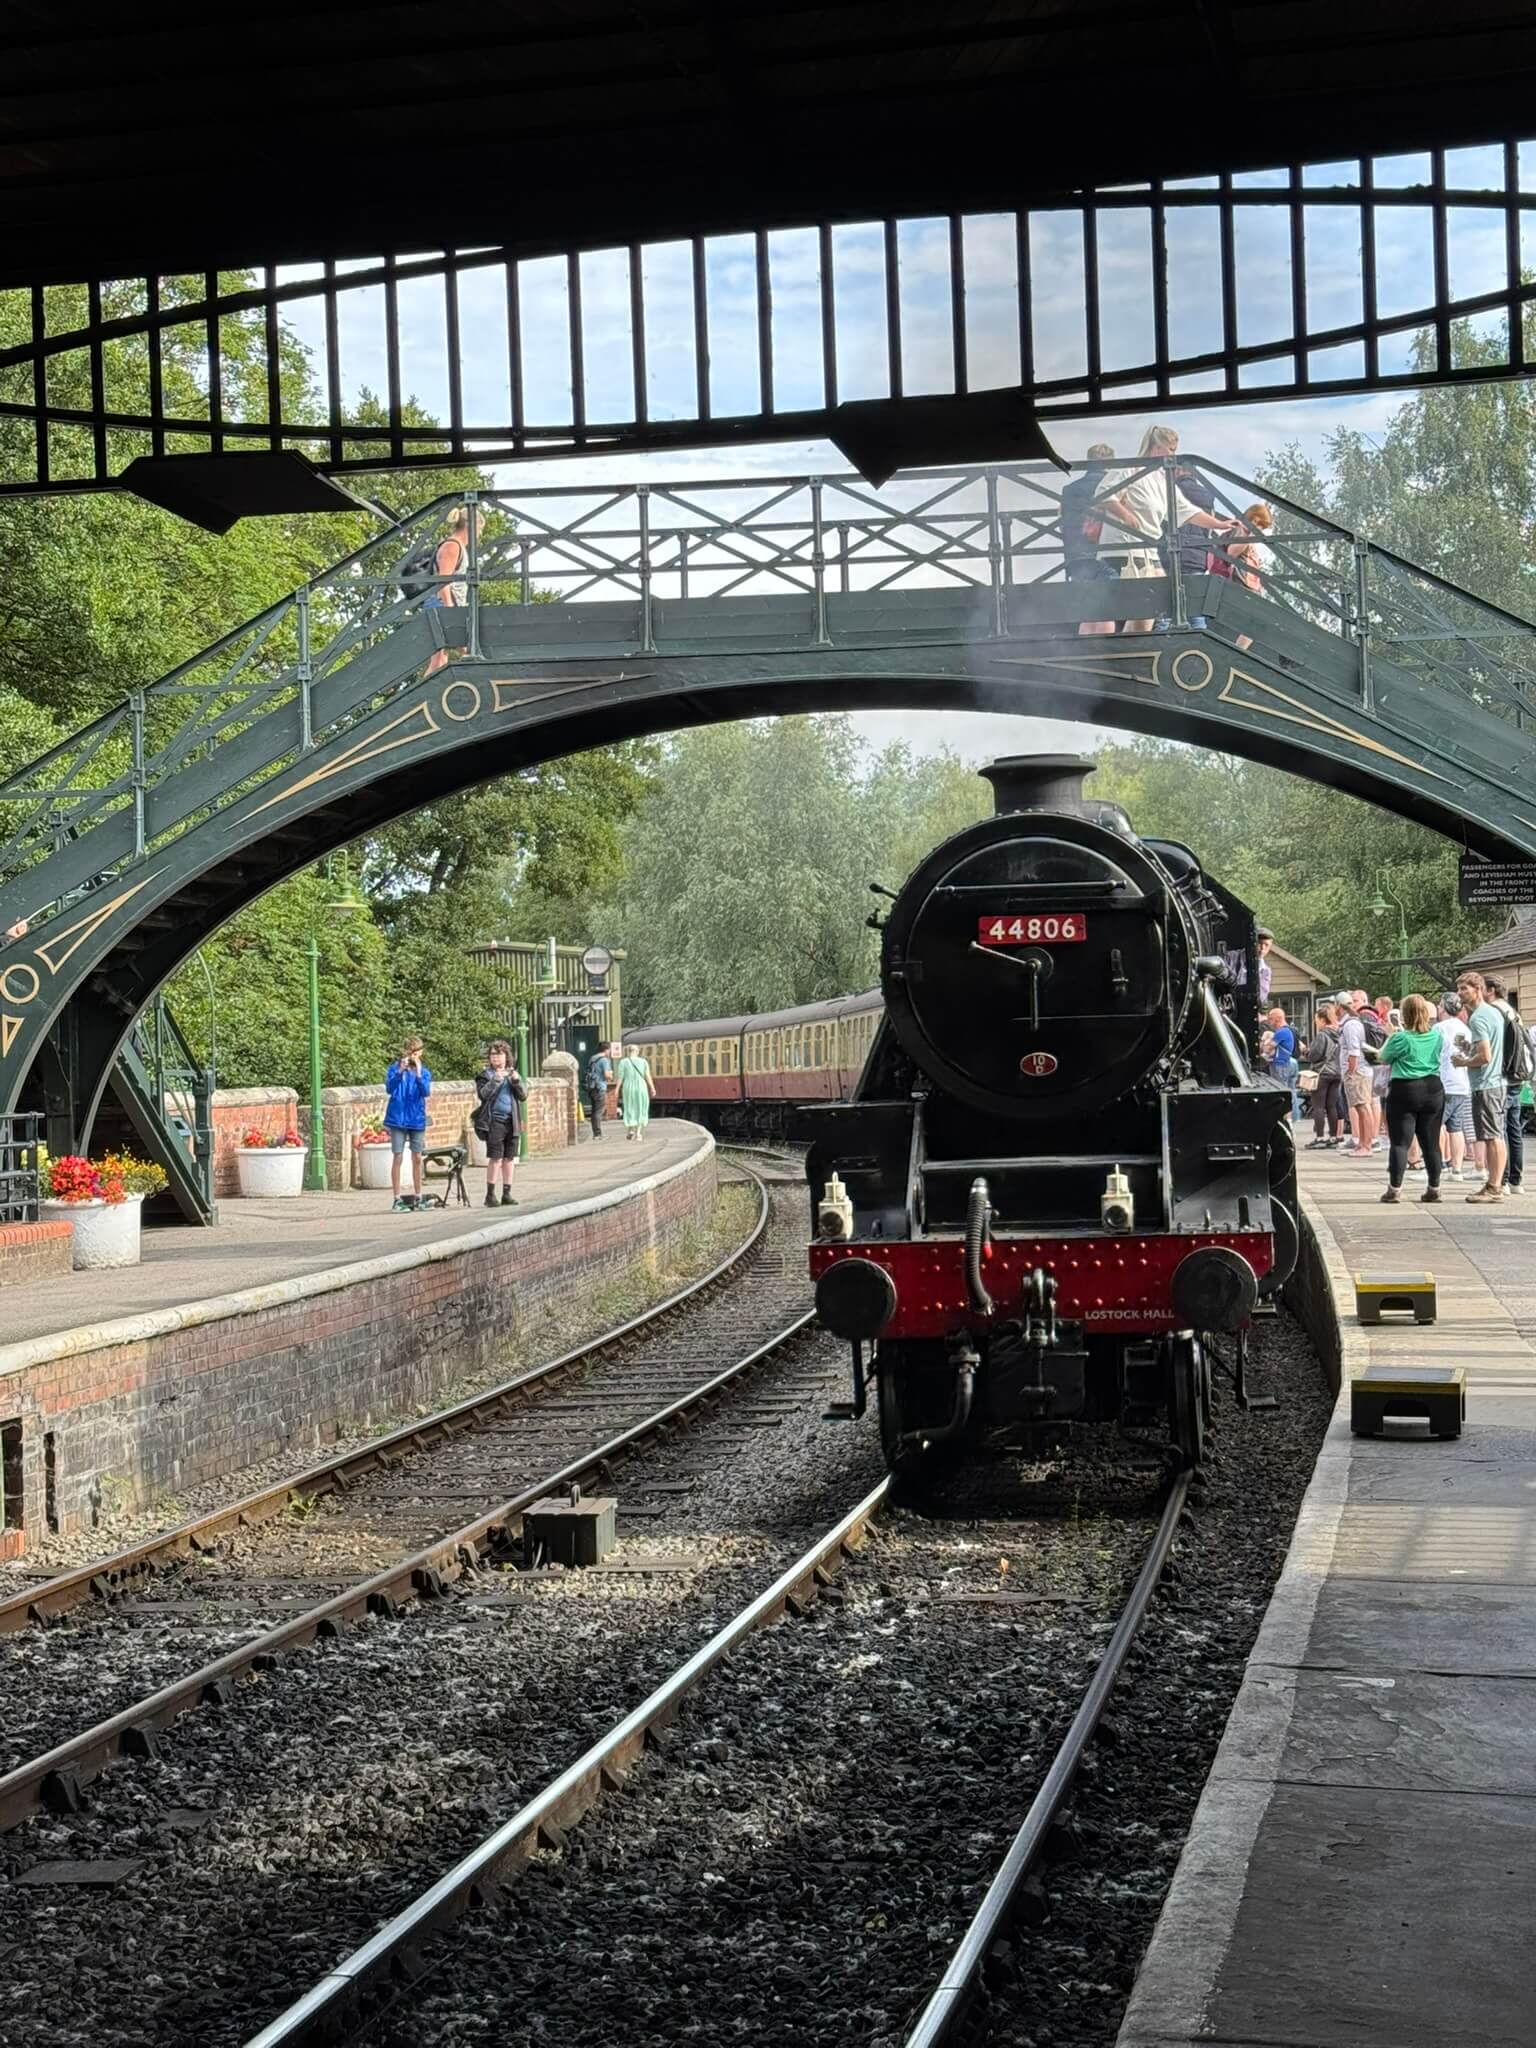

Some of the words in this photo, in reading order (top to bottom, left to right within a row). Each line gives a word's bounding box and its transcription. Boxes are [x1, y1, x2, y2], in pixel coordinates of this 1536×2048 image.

[989, 917, 1076, 941] 44806
[1032, 1055, 1046, 1066] 10
[1084, 1310, 1141, 1320] LOSTOCK
[1143, 1308, 1175, 1319] HALL
